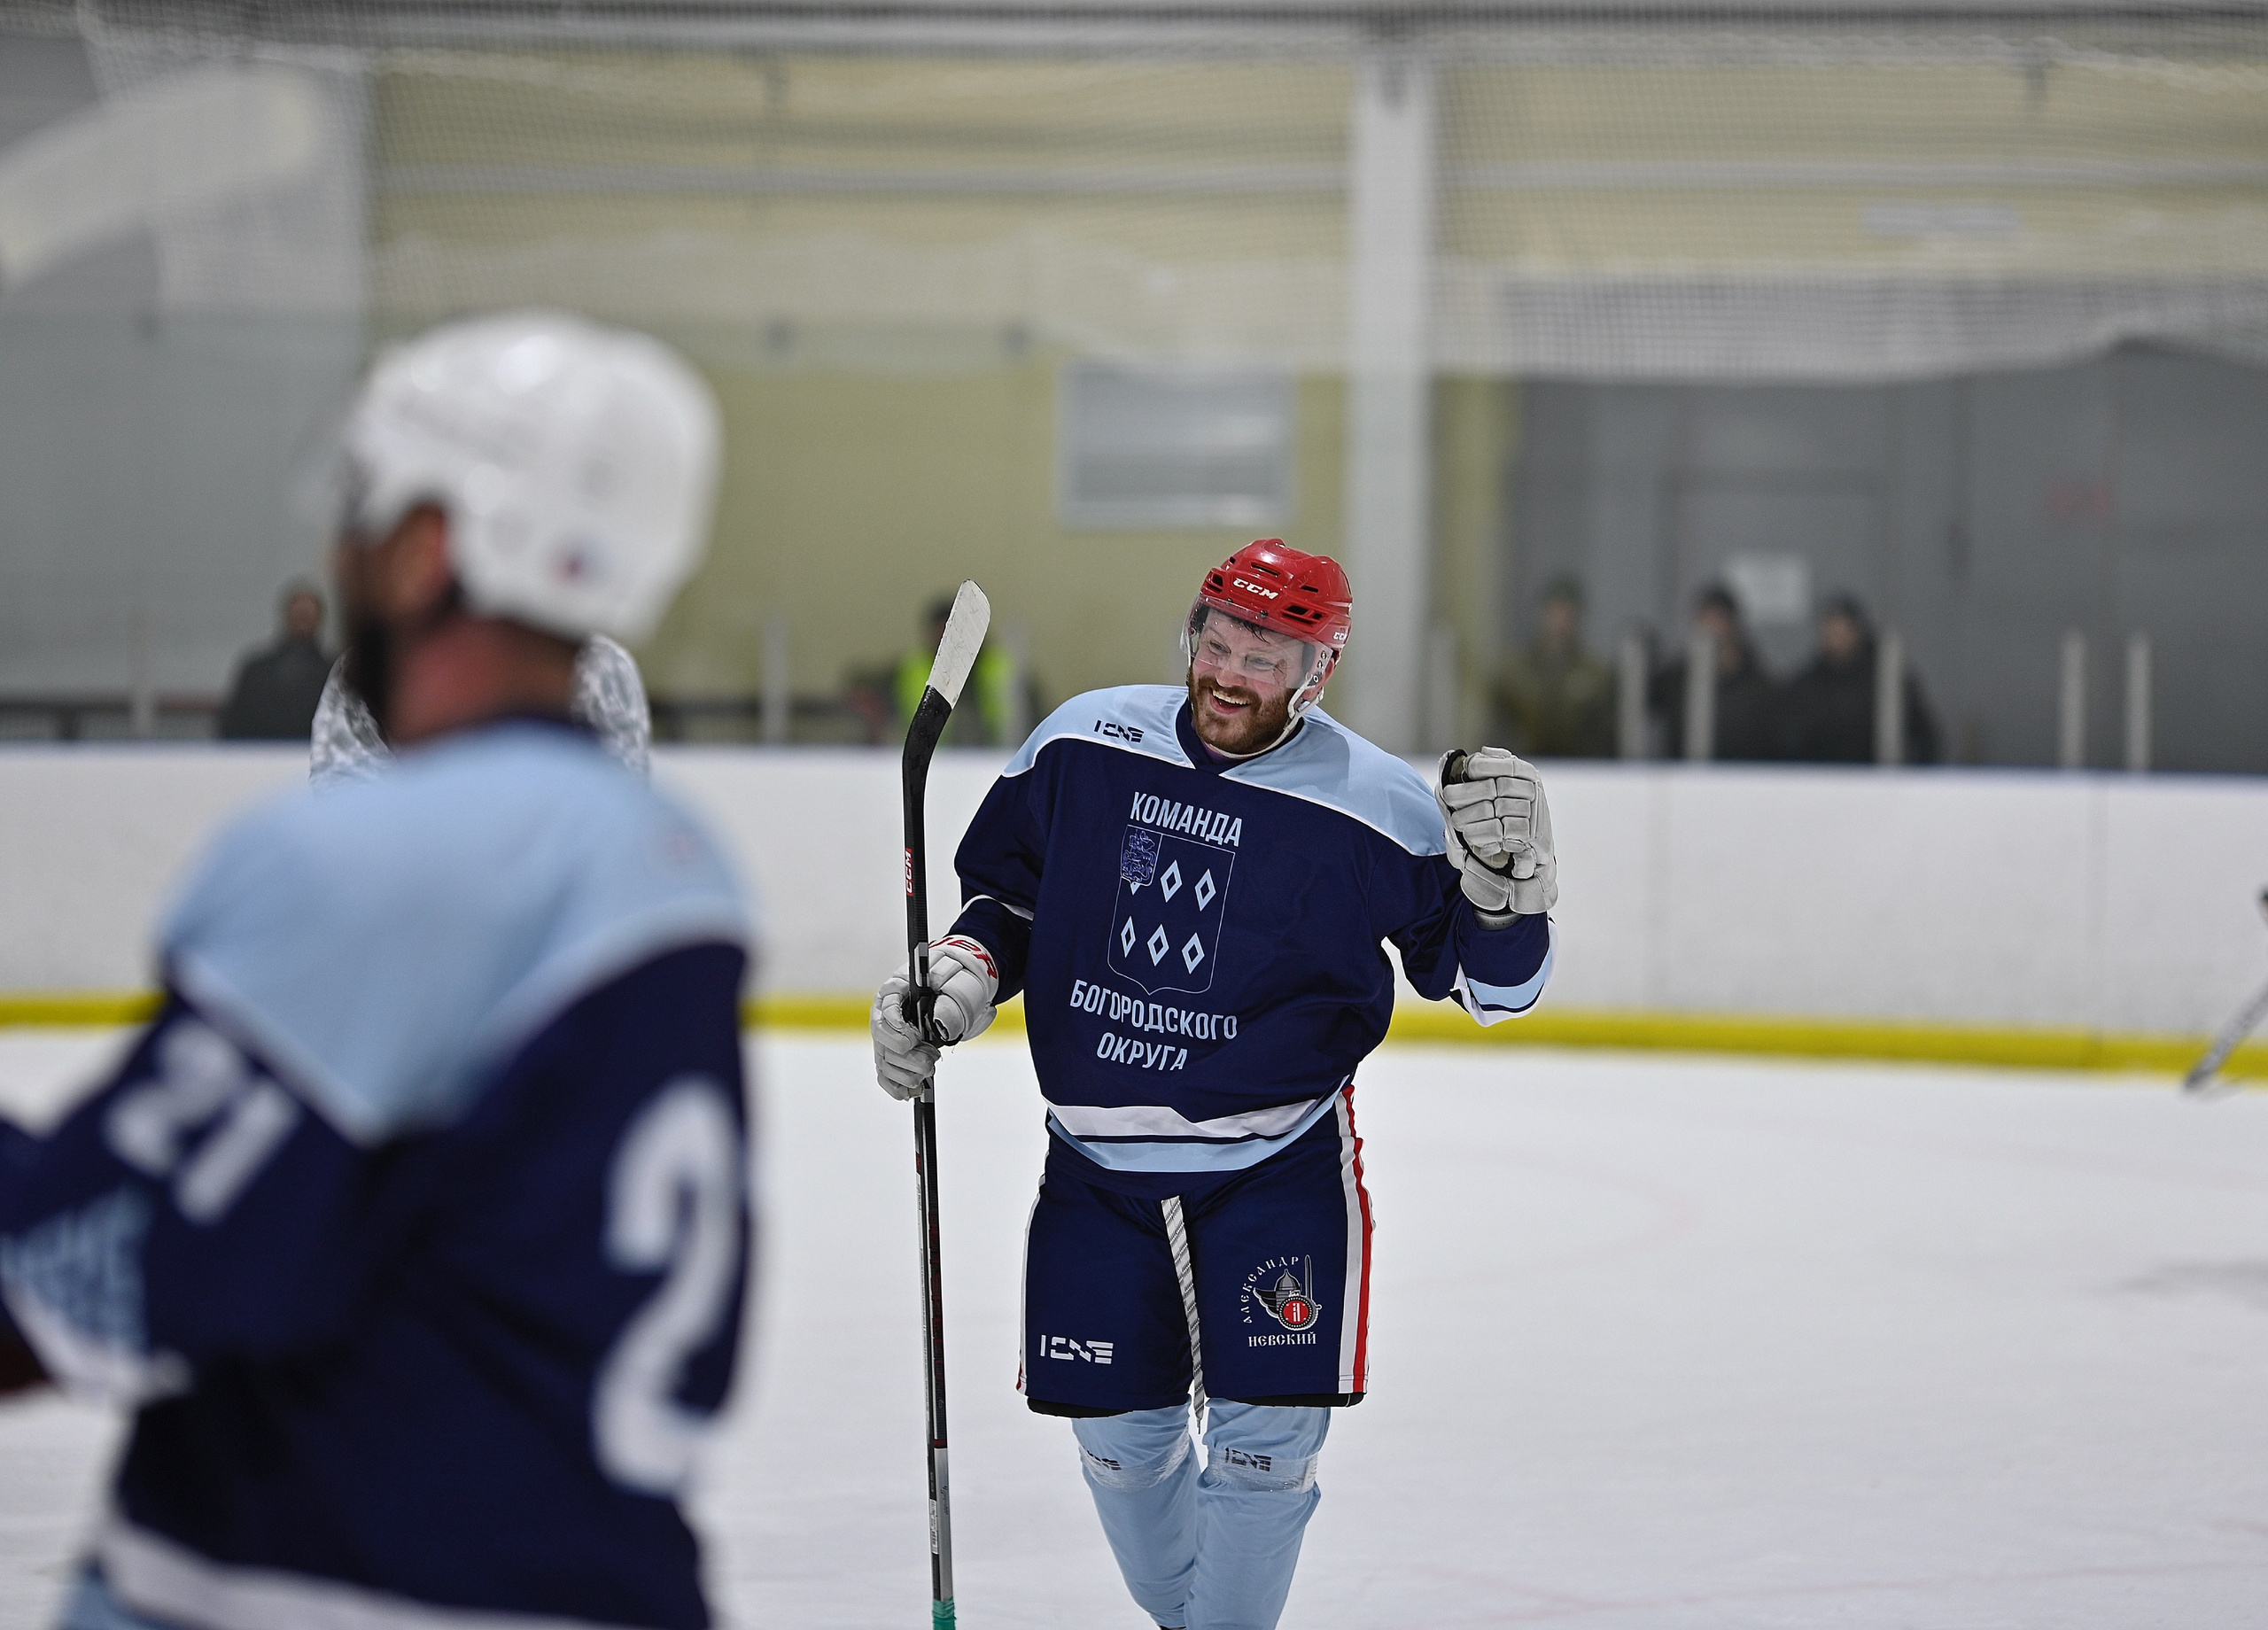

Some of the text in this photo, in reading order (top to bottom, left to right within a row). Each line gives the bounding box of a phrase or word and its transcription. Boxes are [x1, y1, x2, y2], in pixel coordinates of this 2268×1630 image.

[1232, 578, 1279, 600] CCM
[1130, 792, 1242, 847] КОМАНДА
[1070, 980, 1237, 1040] БОГОРОДСКОГО
[1097, 1033, 1187, 1071] ОКРУГА
[1240, 1256, 1299, 1323] АЛЕКСАНДР
[1247, 1331, 1317, 1347] НЕВСКИЙ
